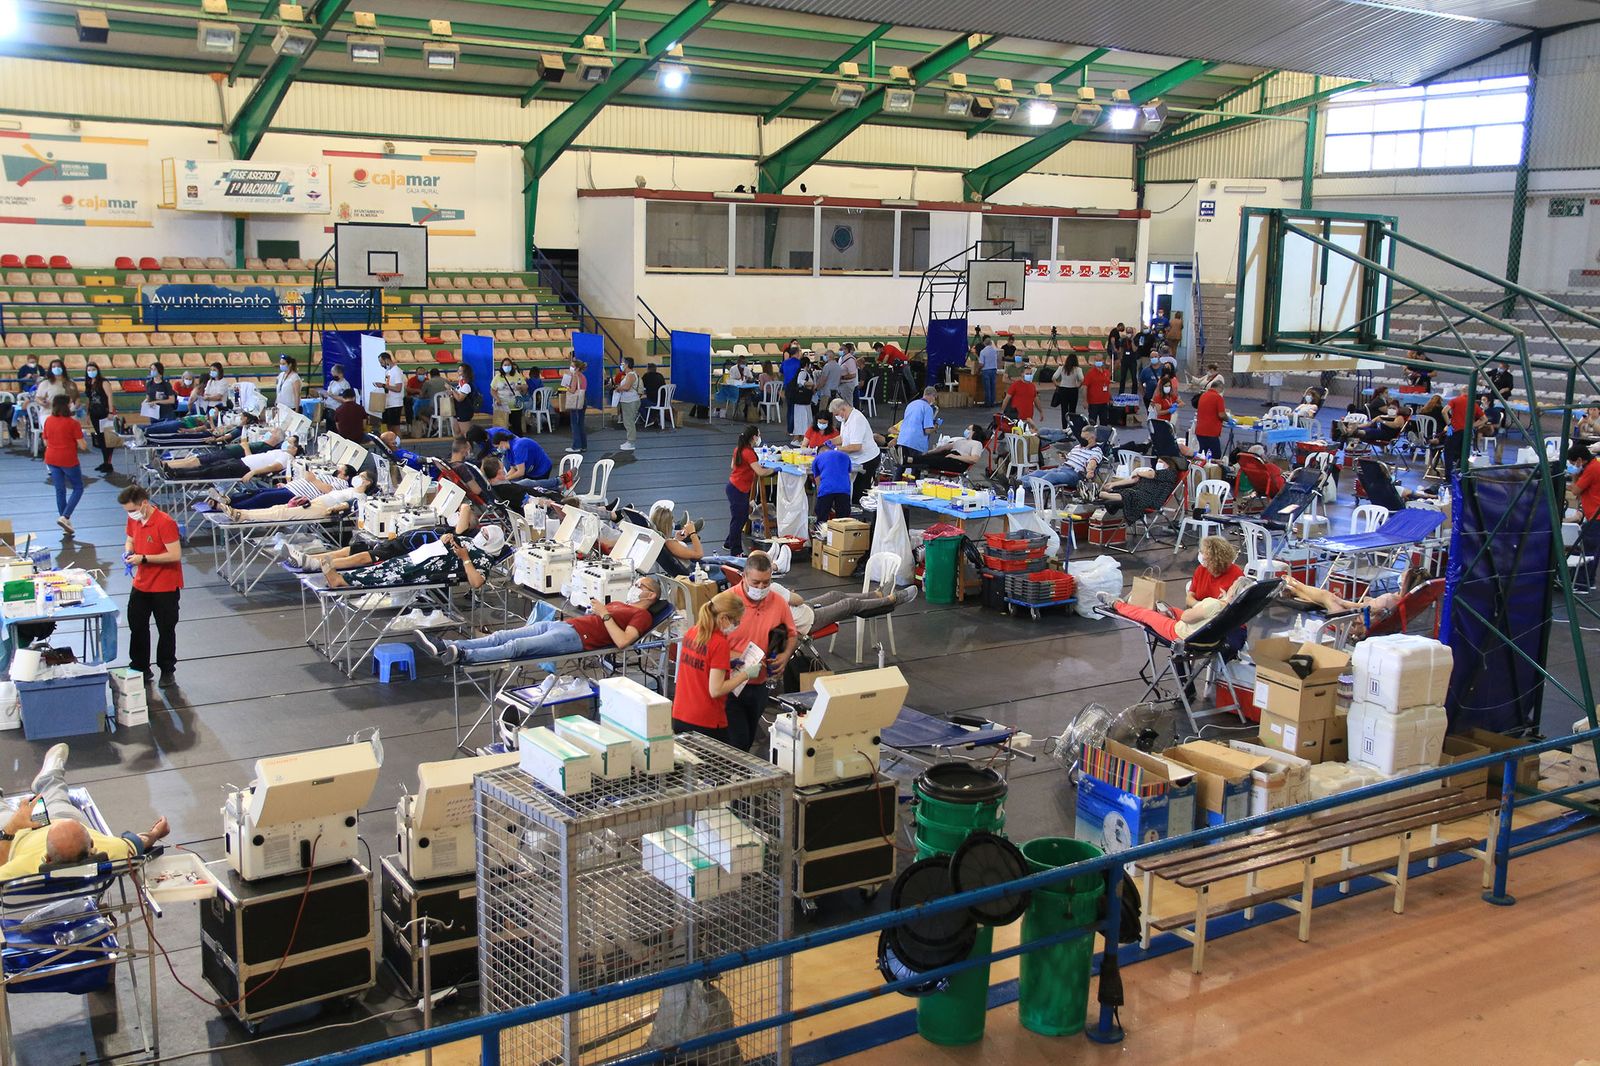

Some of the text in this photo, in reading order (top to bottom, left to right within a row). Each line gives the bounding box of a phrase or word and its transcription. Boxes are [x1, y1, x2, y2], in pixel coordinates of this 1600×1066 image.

[229, 170, 278, 180] FASE ASCENSO
[371, 170, 441, 190] cajamar
[239, 183, 283, 195] NACIONAL
[78, 195, 138, 211] cajamar
[151, 293, 271, 310] Ayuntamiento
